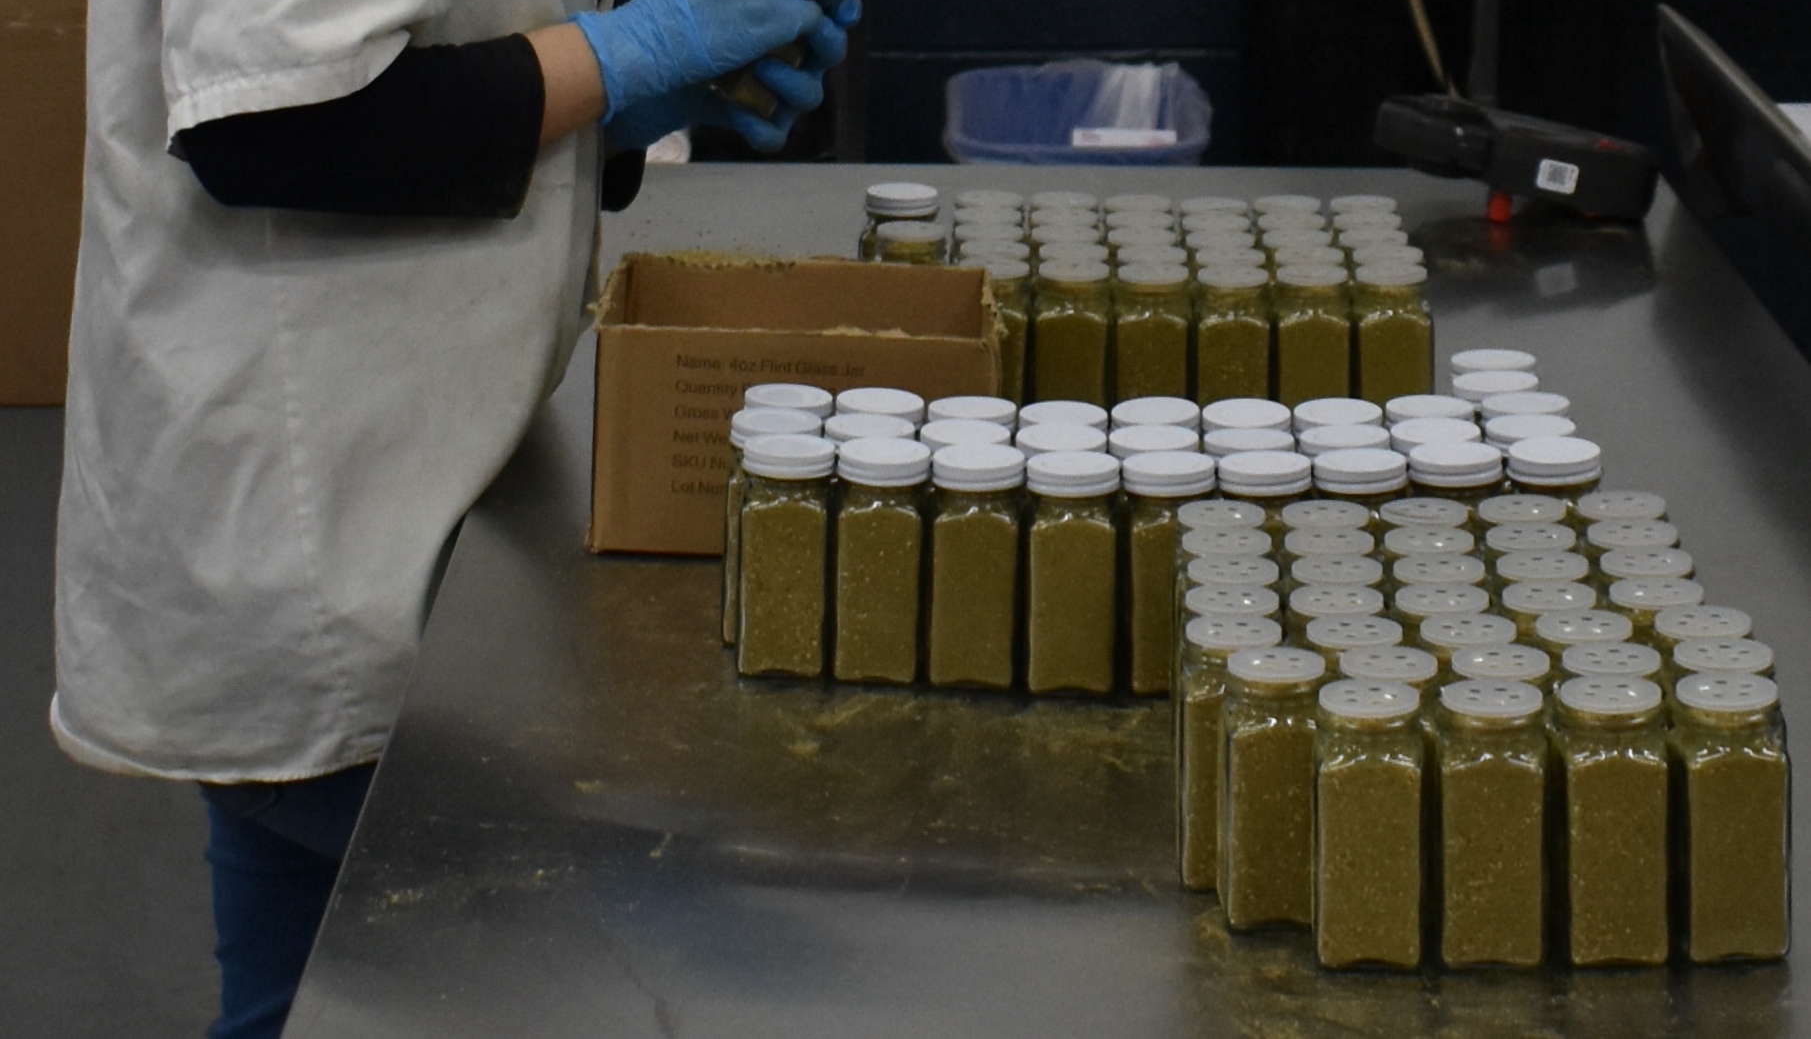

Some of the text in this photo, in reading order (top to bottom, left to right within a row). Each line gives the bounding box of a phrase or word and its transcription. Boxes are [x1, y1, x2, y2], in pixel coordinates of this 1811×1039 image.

[729, 357, 757, 372] 4oz
[760, 358, 792, 373] Flint
[795, 359, 839, 376] Glass
[841, 363, 867, 378] Jar
[675, 380, 738, 399] Quantity
[674, 404, 719, 421] Gross
[673, 429, 699, 445] Net
[671, 453, 706, 470] SKU
[671, 479, 694, 495] Lot
